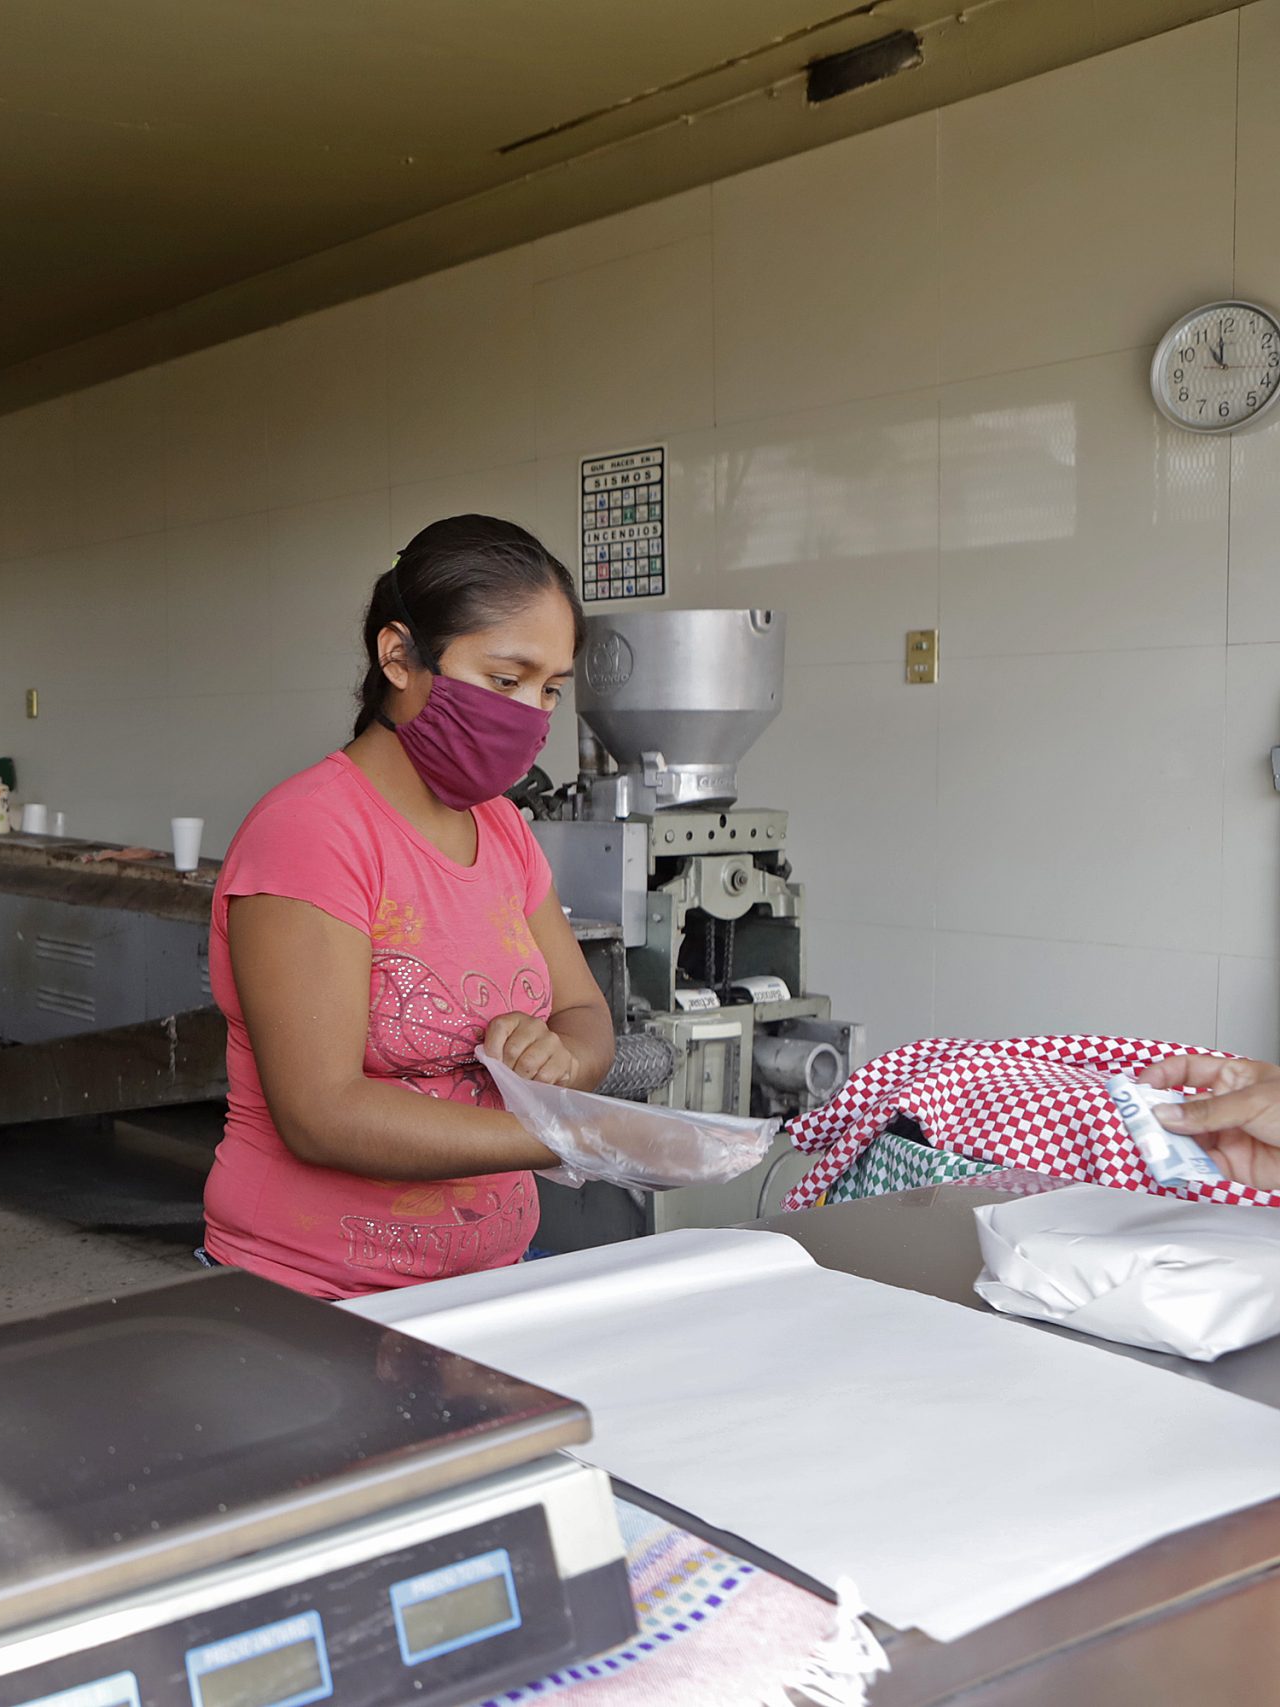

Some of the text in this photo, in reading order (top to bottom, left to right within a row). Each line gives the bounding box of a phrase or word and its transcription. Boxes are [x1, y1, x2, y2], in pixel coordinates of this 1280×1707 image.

[1249, 320, 1256, 335] 1
[1194, 329, 1208, 345] 11
[1261, 333, 1273, 350] 2
[1179, 347, 1195, 363] 10
[1268, 351, 1279, 368] 3
[1173, 369, 1184, 384] 9
[1260, 371, 1271, 388] 4
[1178, 387, 1189, 402] 8
[1246, 391, 1257, 407] 5
[1196, 399, 1207, 415] 7
[1218, 401, 1230, 417] 6
[594, 470, 651, 488] SISMOS
[587, 524, 658, 543] INCENDIOS
[1112, 1090, 1140, 1119] 20
